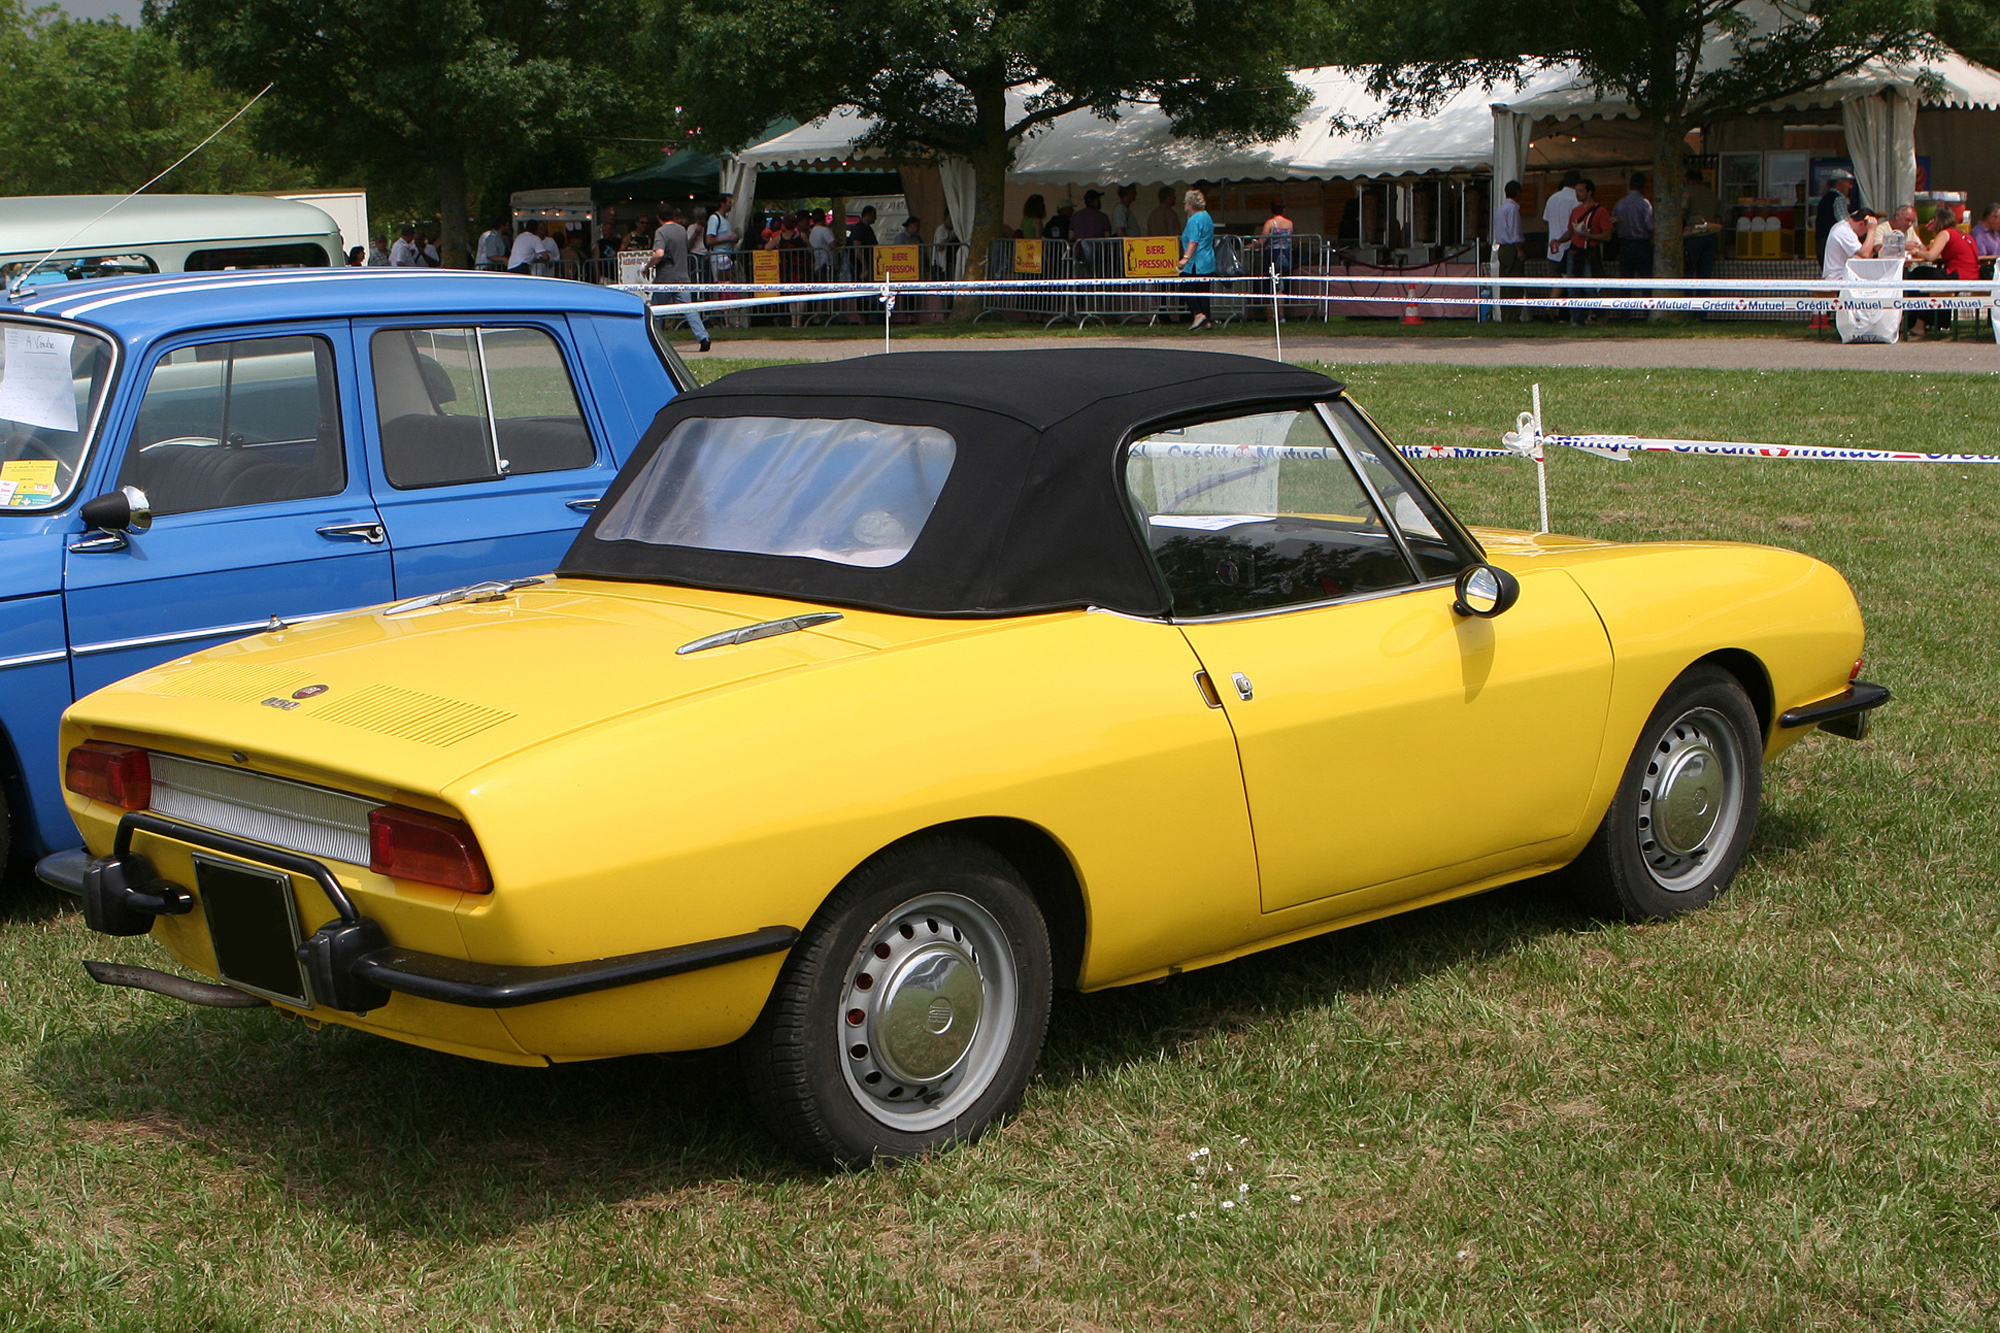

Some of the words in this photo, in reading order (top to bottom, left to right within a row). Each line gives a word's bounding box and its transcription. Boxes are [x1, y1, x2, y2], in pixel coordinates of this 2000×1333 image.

[1146, 245, 1165, 255] BIERE
[892, 252, 908, 261] BIERE
[1138, 259, 1174, 268] PRESSION
[886, 265, 915, 273] PRESSION
[1568, 299, 1603, 307] Mutuel
[1612, 299, 1644, 308] Crédit
[1656, 300, 1692, 309] Mutuel
[1702, 300, 1734, 310] Crédit
[1748, 301, 1785, 310] Mutuel
[1796, 300, 1830, 310] Crédit
[1844, 300, 1882, 310] Mutuel
[1893, 300, 1928, 309] Crédit
[1942, 299, 1982, 309] Mutuel
